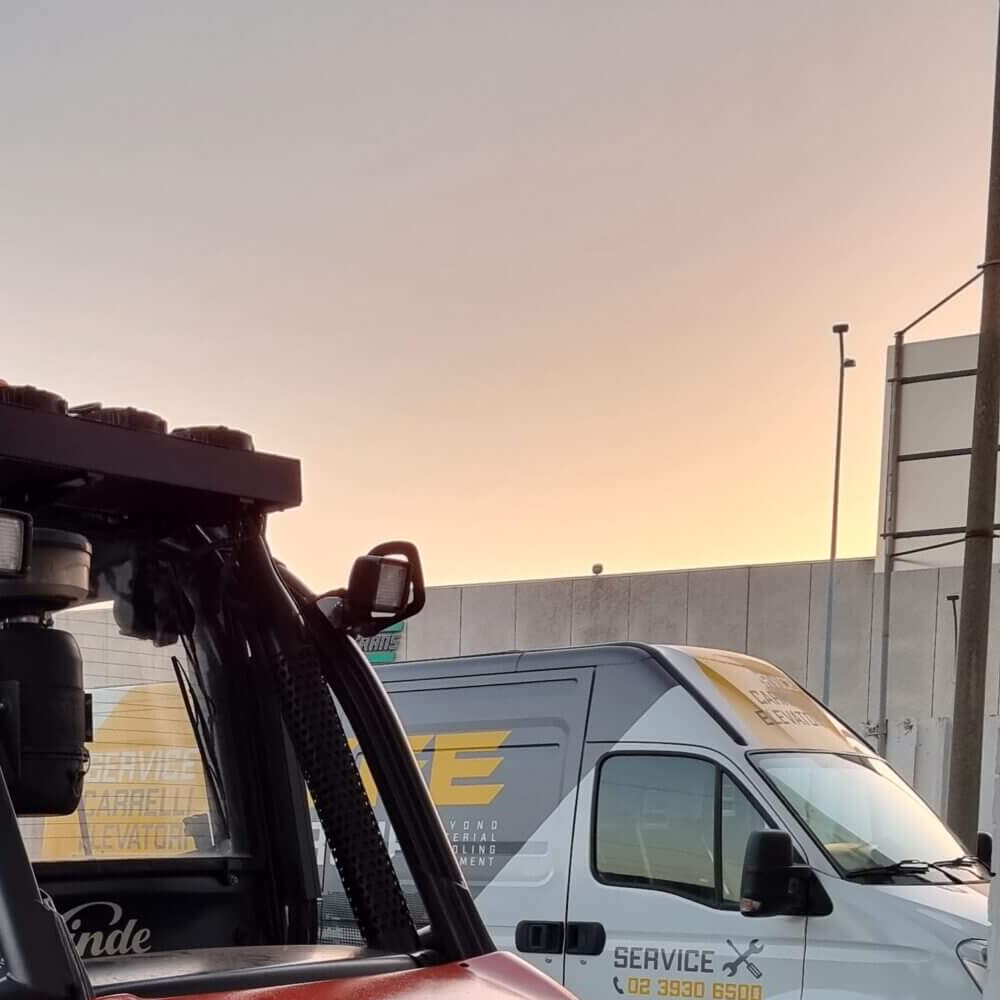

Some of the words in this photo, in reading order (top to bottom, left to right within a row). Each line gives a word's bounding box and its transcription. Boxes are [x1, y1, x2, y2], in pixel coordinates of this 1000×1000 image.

[355, 632, 402, 652] RANS
[449, 819, 498, 830] YOND
[452, 831, 497, 842] ERIAL
[459, 856, 495, 867] MENT
[613, 946, 715, 973] SERVICE
[627, 977, 650, 995] 02
[657, 979, 705, 999] 3930
